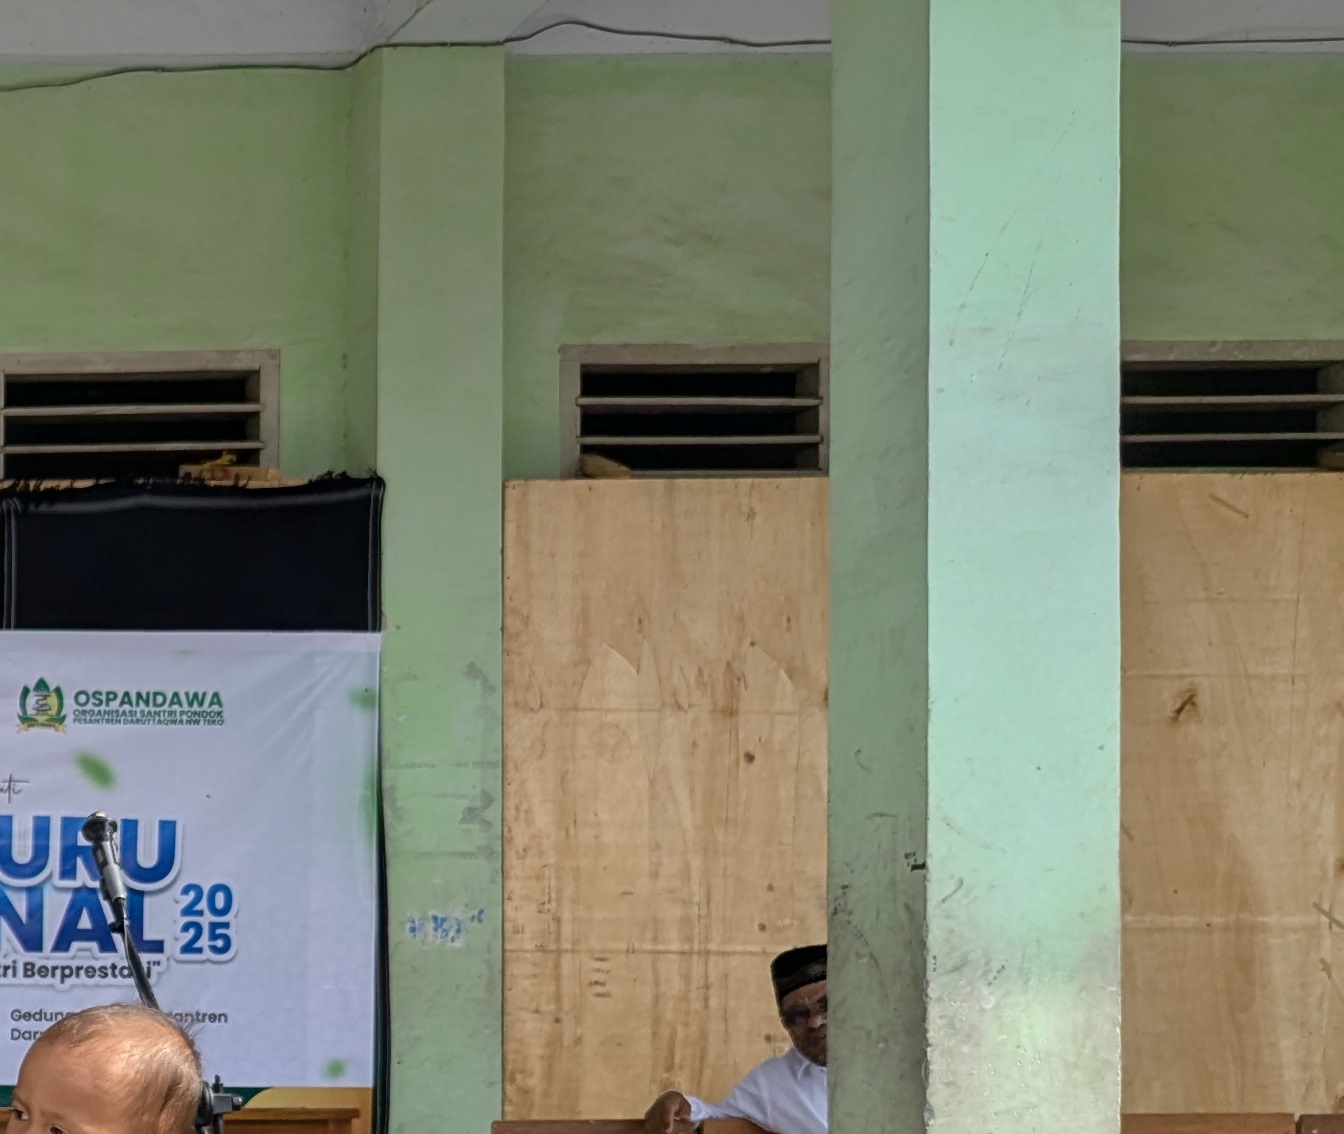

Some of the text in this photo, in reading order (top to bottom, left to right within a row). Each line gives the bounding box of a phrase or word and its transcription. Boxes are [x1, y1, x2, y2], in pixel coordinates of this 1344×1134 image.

[73, 690, 224, 708] OSPANDAWA
[73, 709, 224, 719] ORGANISASI SANTRI PONDOK
[73, 717, 121, 725] PESANTREN
[122, 717, 184, 726] DARUTTAQWA
[203, 718, 224, 726] TEKO
[179, 883, 233, 918] 20
[179, 920, 232, 955] 25
